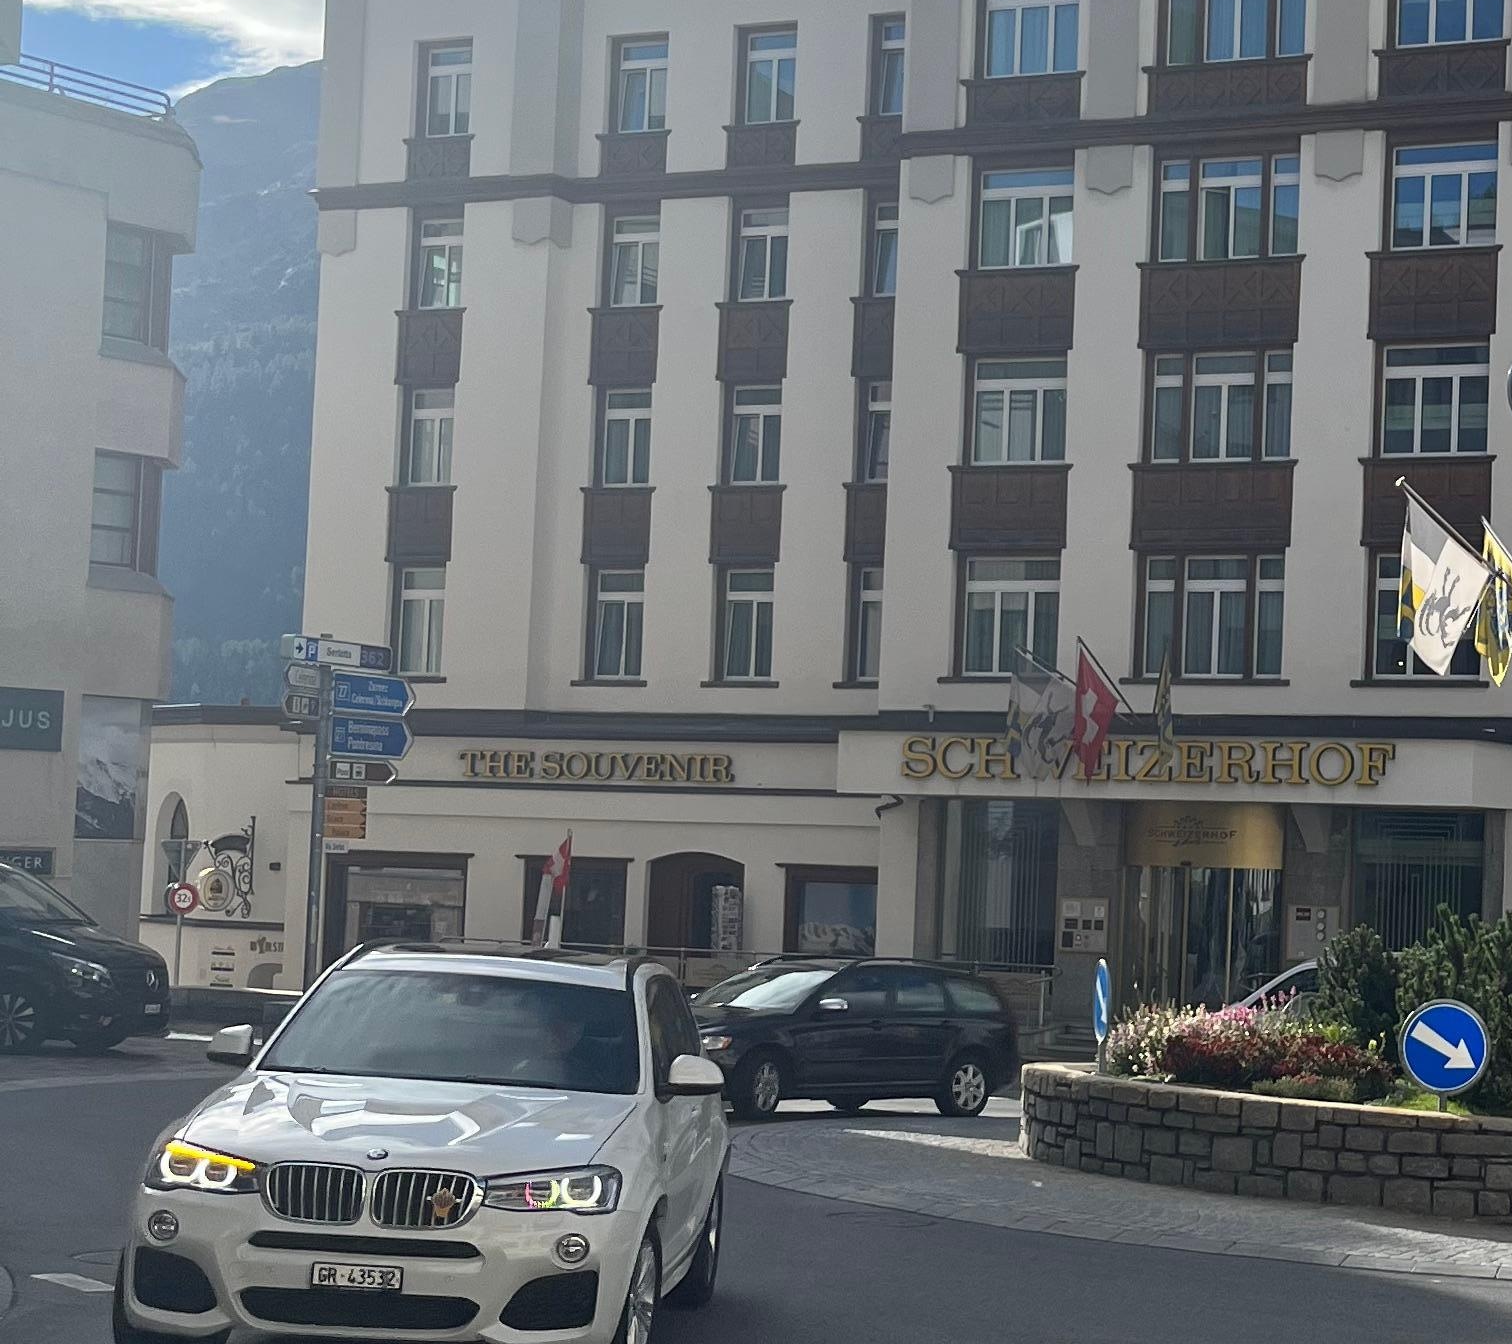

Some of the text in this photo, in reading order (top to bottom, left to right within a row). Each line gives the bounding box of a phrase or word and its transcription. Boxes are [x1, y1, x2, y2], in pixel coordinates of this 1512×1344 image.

[360, 649, 385, 667] 362
[1, 709, 51, 729] JUS
[458, 750, 736, 784] THE SOUVENIR
[1147, 828, 1239, 841] SCHWEIZERHOF
[318, 1266, 338, 1284] GR
